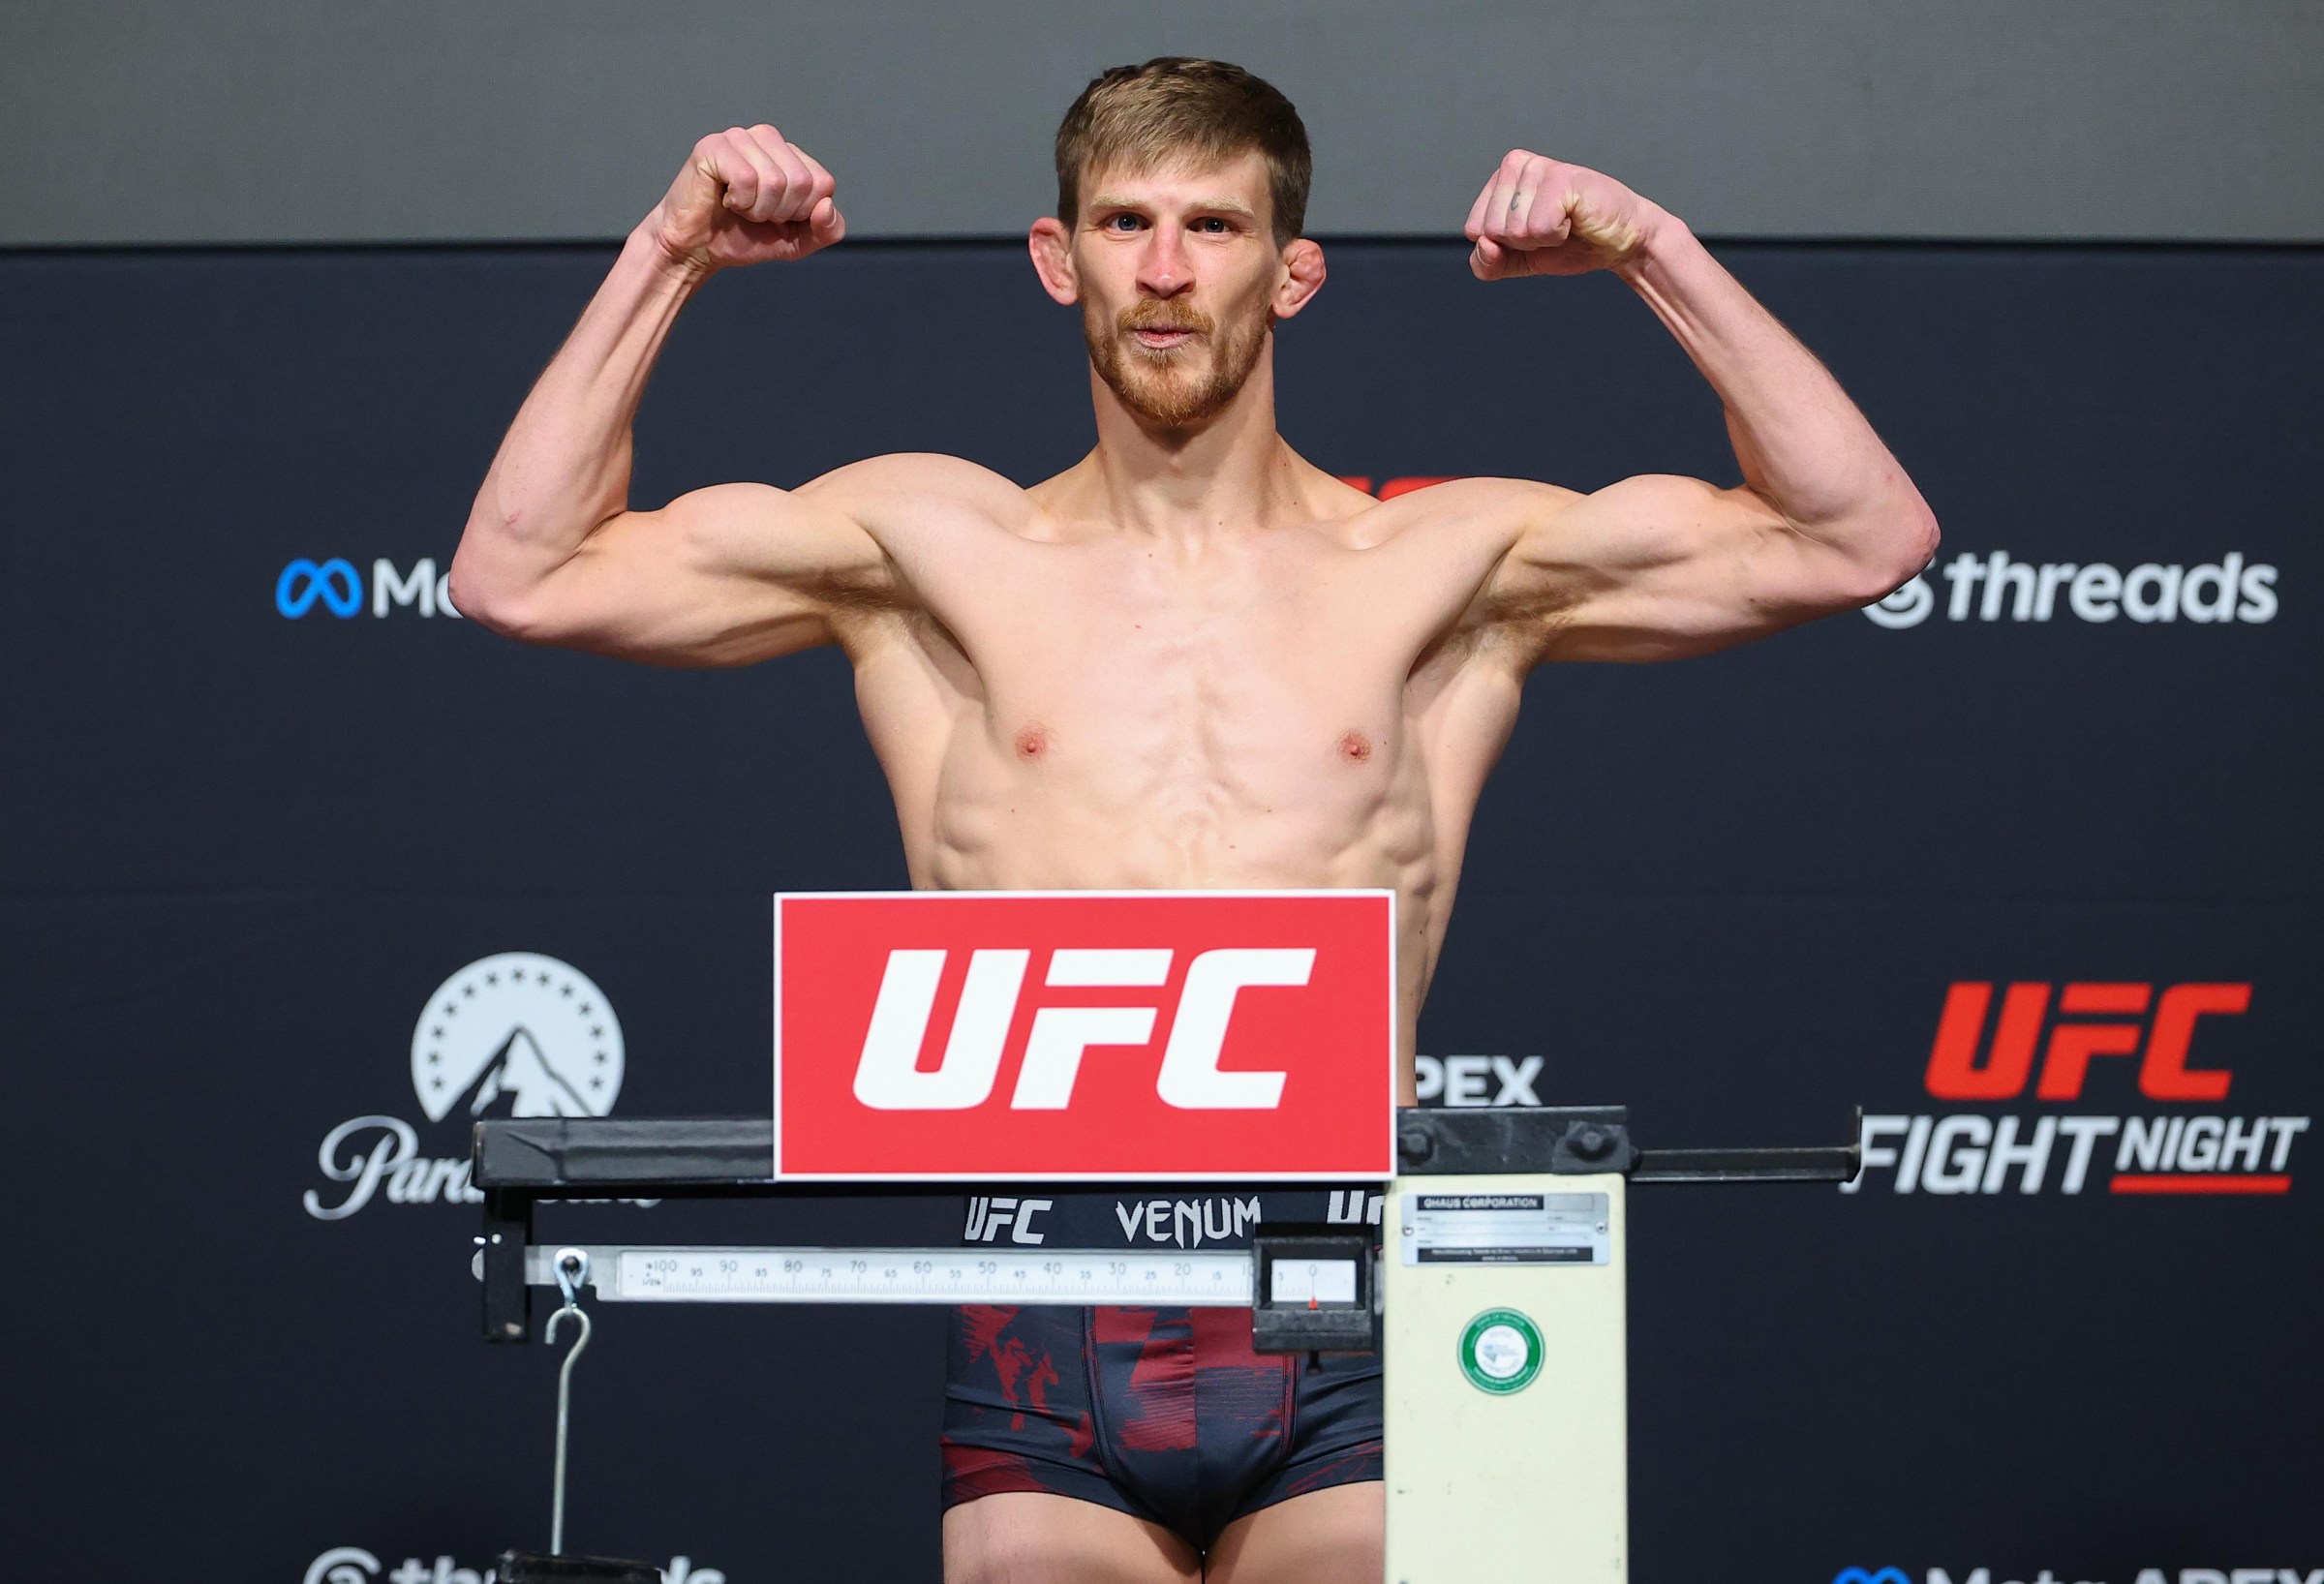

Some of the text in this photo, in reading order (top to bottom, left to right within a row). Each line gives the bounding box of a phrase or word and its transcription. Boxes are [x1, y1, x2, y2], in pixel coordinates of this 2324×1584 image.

[1942, 551, 2279, 624] threads
[853, 948, 1317, 1111] UFC
[1924, 982, 2253, 1101] UFC
[1839, 1114, 2310, 1195] FIGHT NIGHT
[963, 1197, 1054, 1245] UFC
[1115, 1195, 1262, 1249] VENUM
[1462, 1197, 1538, 1208] CORPORATION
[654, 1259, 677, 1272] 100
[719, 1259, 738, 1272] 90
[783, 1260, 803, 1273] 80
[851, 1260, 867, 1274] 70
[913, 1261, 933, 1274] 60
[978, 1261, 997, 1274] 50
[1044, 1262, 1061, 1275] 40
[1109, 1262, 1126, 1275] 30
[1145, 1270, 1156, 1280] 25
[1174, 1263, 1191, 1276] 20
[1278, 1271, 1284, 1281] 5
[1308, 1264, 1317, 1277] 0
